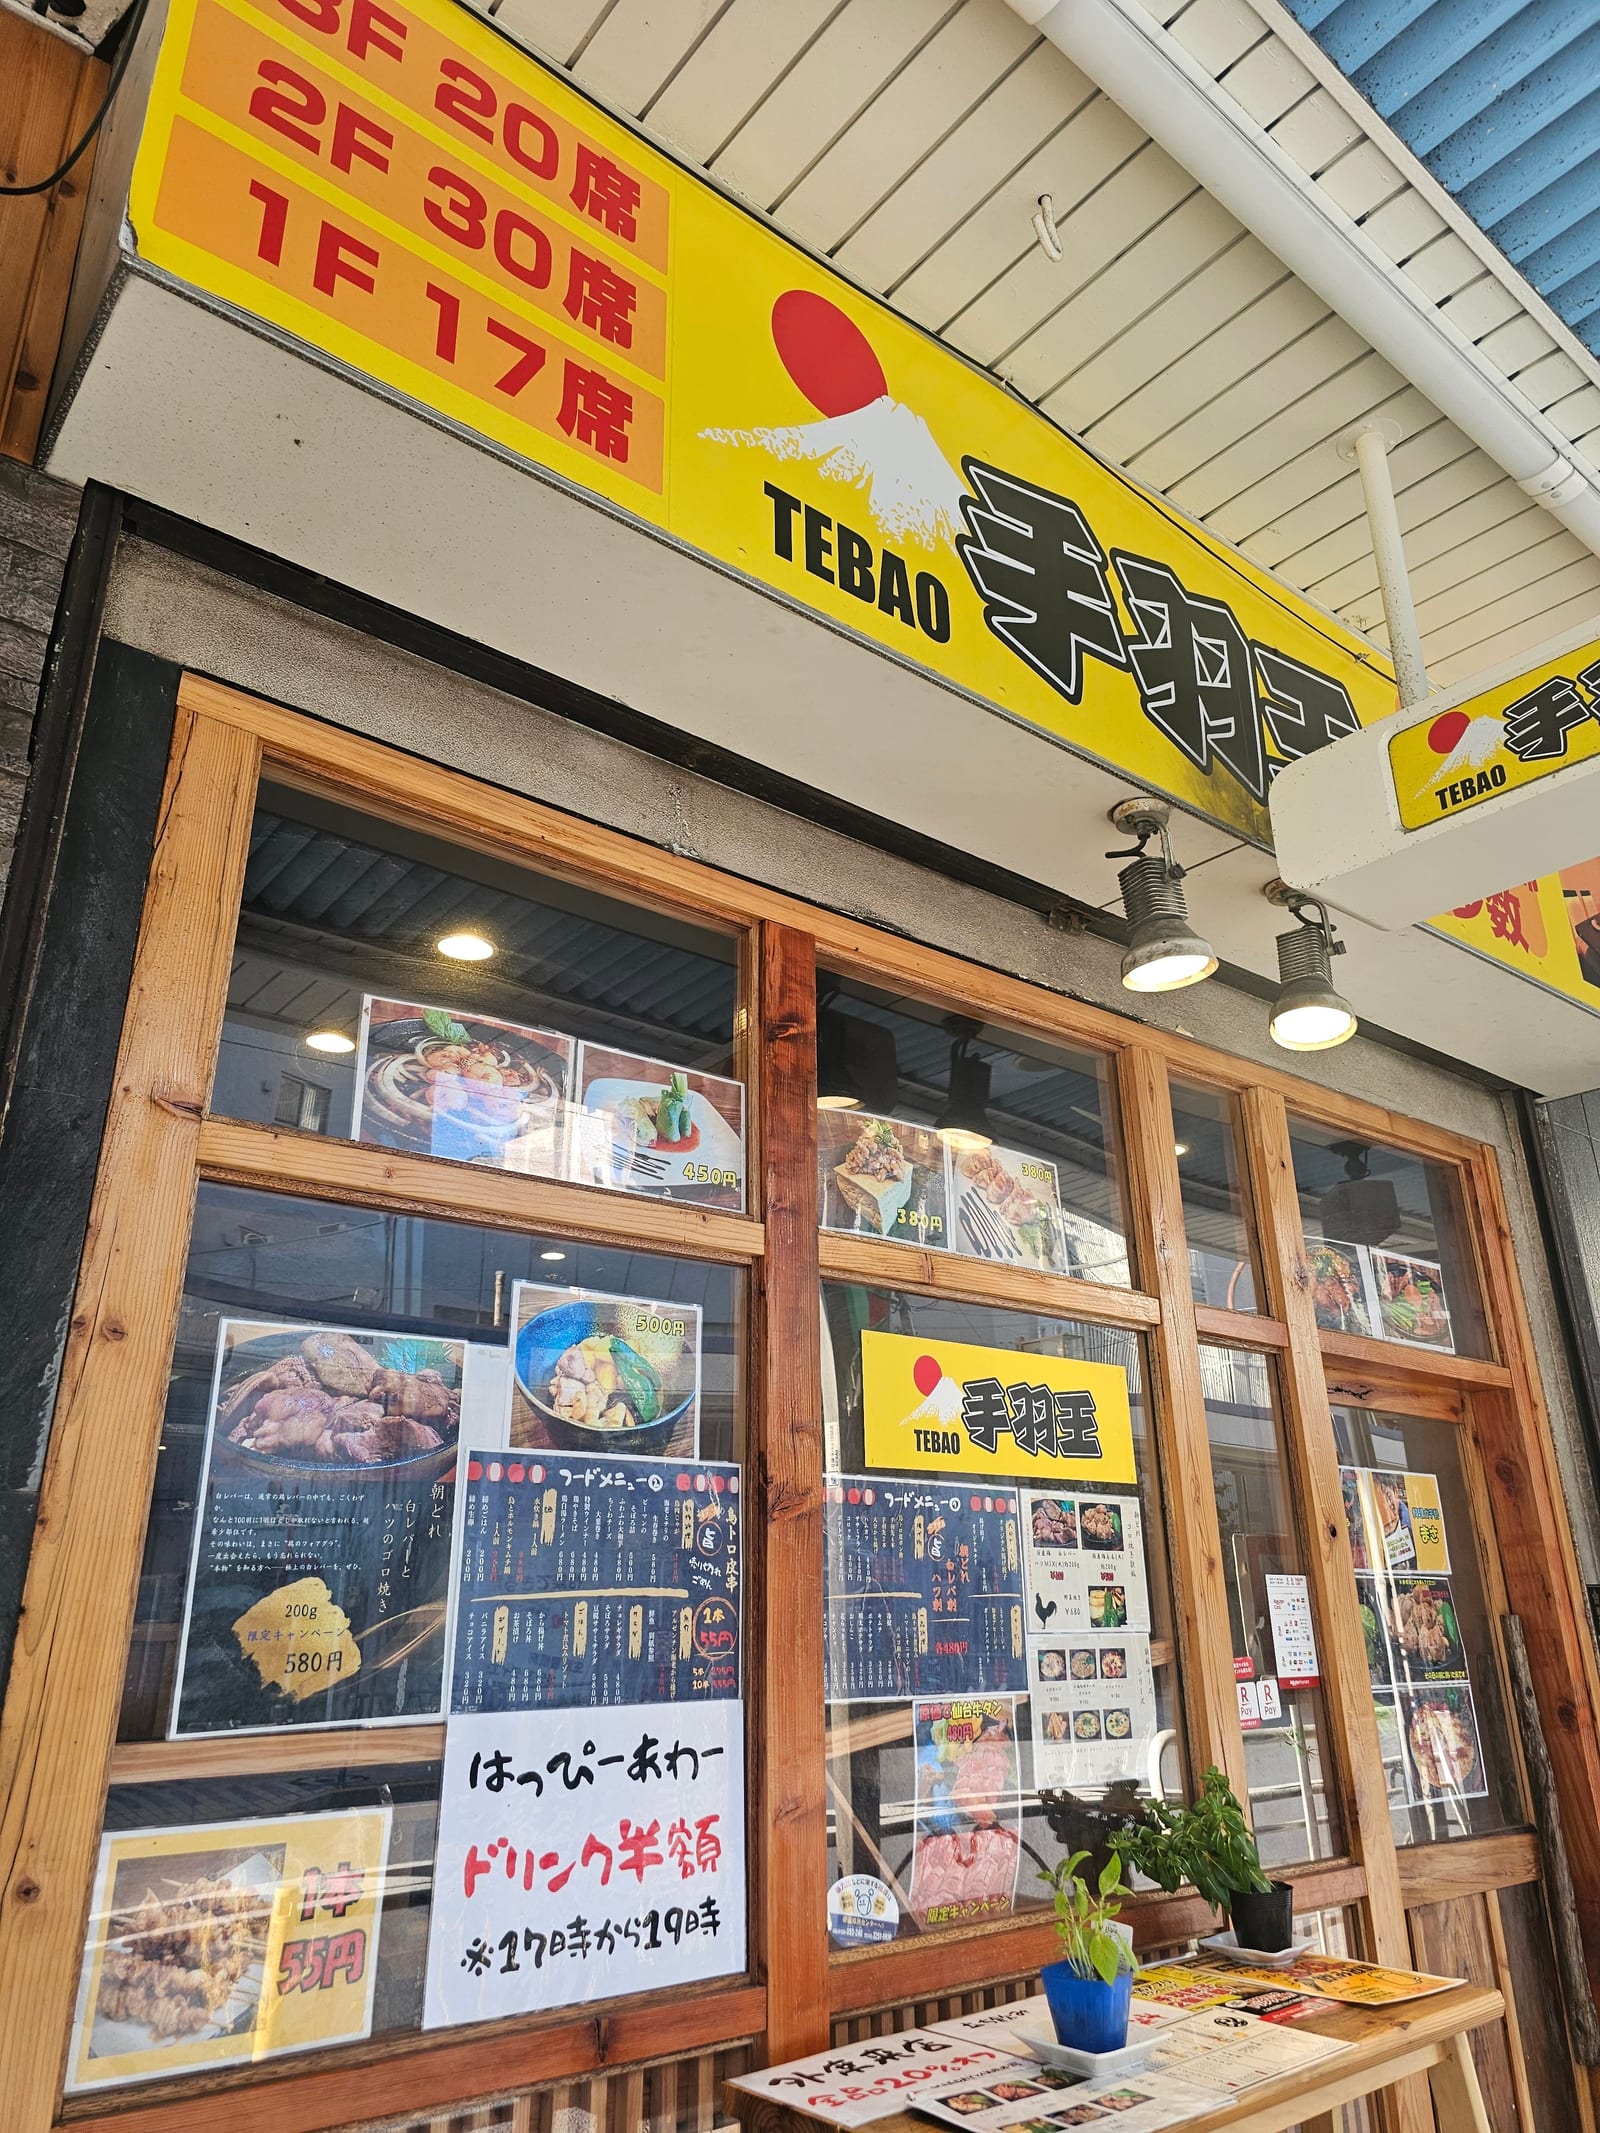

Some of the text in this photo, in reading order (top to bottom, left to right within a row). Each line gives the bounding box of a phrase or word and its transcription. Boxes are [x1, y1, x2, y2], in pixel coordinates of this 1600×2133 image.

[434, 58, 642, 243] 20席
[248, 59, 637, 349] 2F 30席
[249, 178, 634, 464] 1F 17席
[763, 480, 951, 644] TEBAO
[1502, 658, 1600, 763] 手
[1434, 764, 1507, 812] TEBAO
[683, 1162, 738, 1189] 450円
[1021, 1162, 1053, 1185] 380円
[896, 1208, 944, 1233] 380円
[636, 1314, 687, 1337] 500円
[961, 1376, 1103, 1459] 手羽王
[913, 1428, 961, 1455] TEBAO
[428, 1483, 446, 1539] 朝どれ
[583, 1495, 591, 1547] 特製ウインナー
[606, 1497, 614, 1540] ちくわチーズ
[640, 1498, 648, 1535] ピーマンの
[401, 1499, 418, 1580] 白レバーと
[492, 1522, 501, 1545] 1人前
[725, 1506, 739, 1594] 鳥トロ皮串
[1419, 1524, 1440, 1545] まさ
[377, 1502, 397, 1614] ハツのゴロ焼き
[463, 1549, 471, 1582] 200円
[477, 1549, 485, 1582] 200円
[959, 1543, 971, 1584] 朝どれ
[692, 1575, 713, 1591] ごめん
[285, 1604, 318, 1620] 200g
[512, 1612, 520, 1644] お茶漬け
[525, 1611, 533, 1644] そぼろ丼
[703, 1607, 726, 1625] 1本
[247, 1627, 347, 1642] 限定キャンペーン
[465, 1612, 475, 1660] チョコアイス
[479, 1612, 489, 1660] バニラアイス
[537, 1611, 546, 1651] から揚げ丼
[700, 1630, 734, 1649] 55円
[935, 1640, 968, 1655] 各480円
[284, 1651, 343, 1675] 580円
[692, 1667, 705, 1677] 5本
[462, 1671, 470, 1705] 320円
[475, 1671, 483, 1705] 320円
[692, 1680, 710, 1690] 10本
[1240, 1707, 1252, 1716] Pay
[1264, 1706, 1276, 1716] Pay
[469, 1733, 725, 1797] はっぴーあわー
[463, 1814, 723, 1898] ドリンク半額
[300, 1861, 365, 1922] 1本
[277, 1928, 367, 1997] 55円
